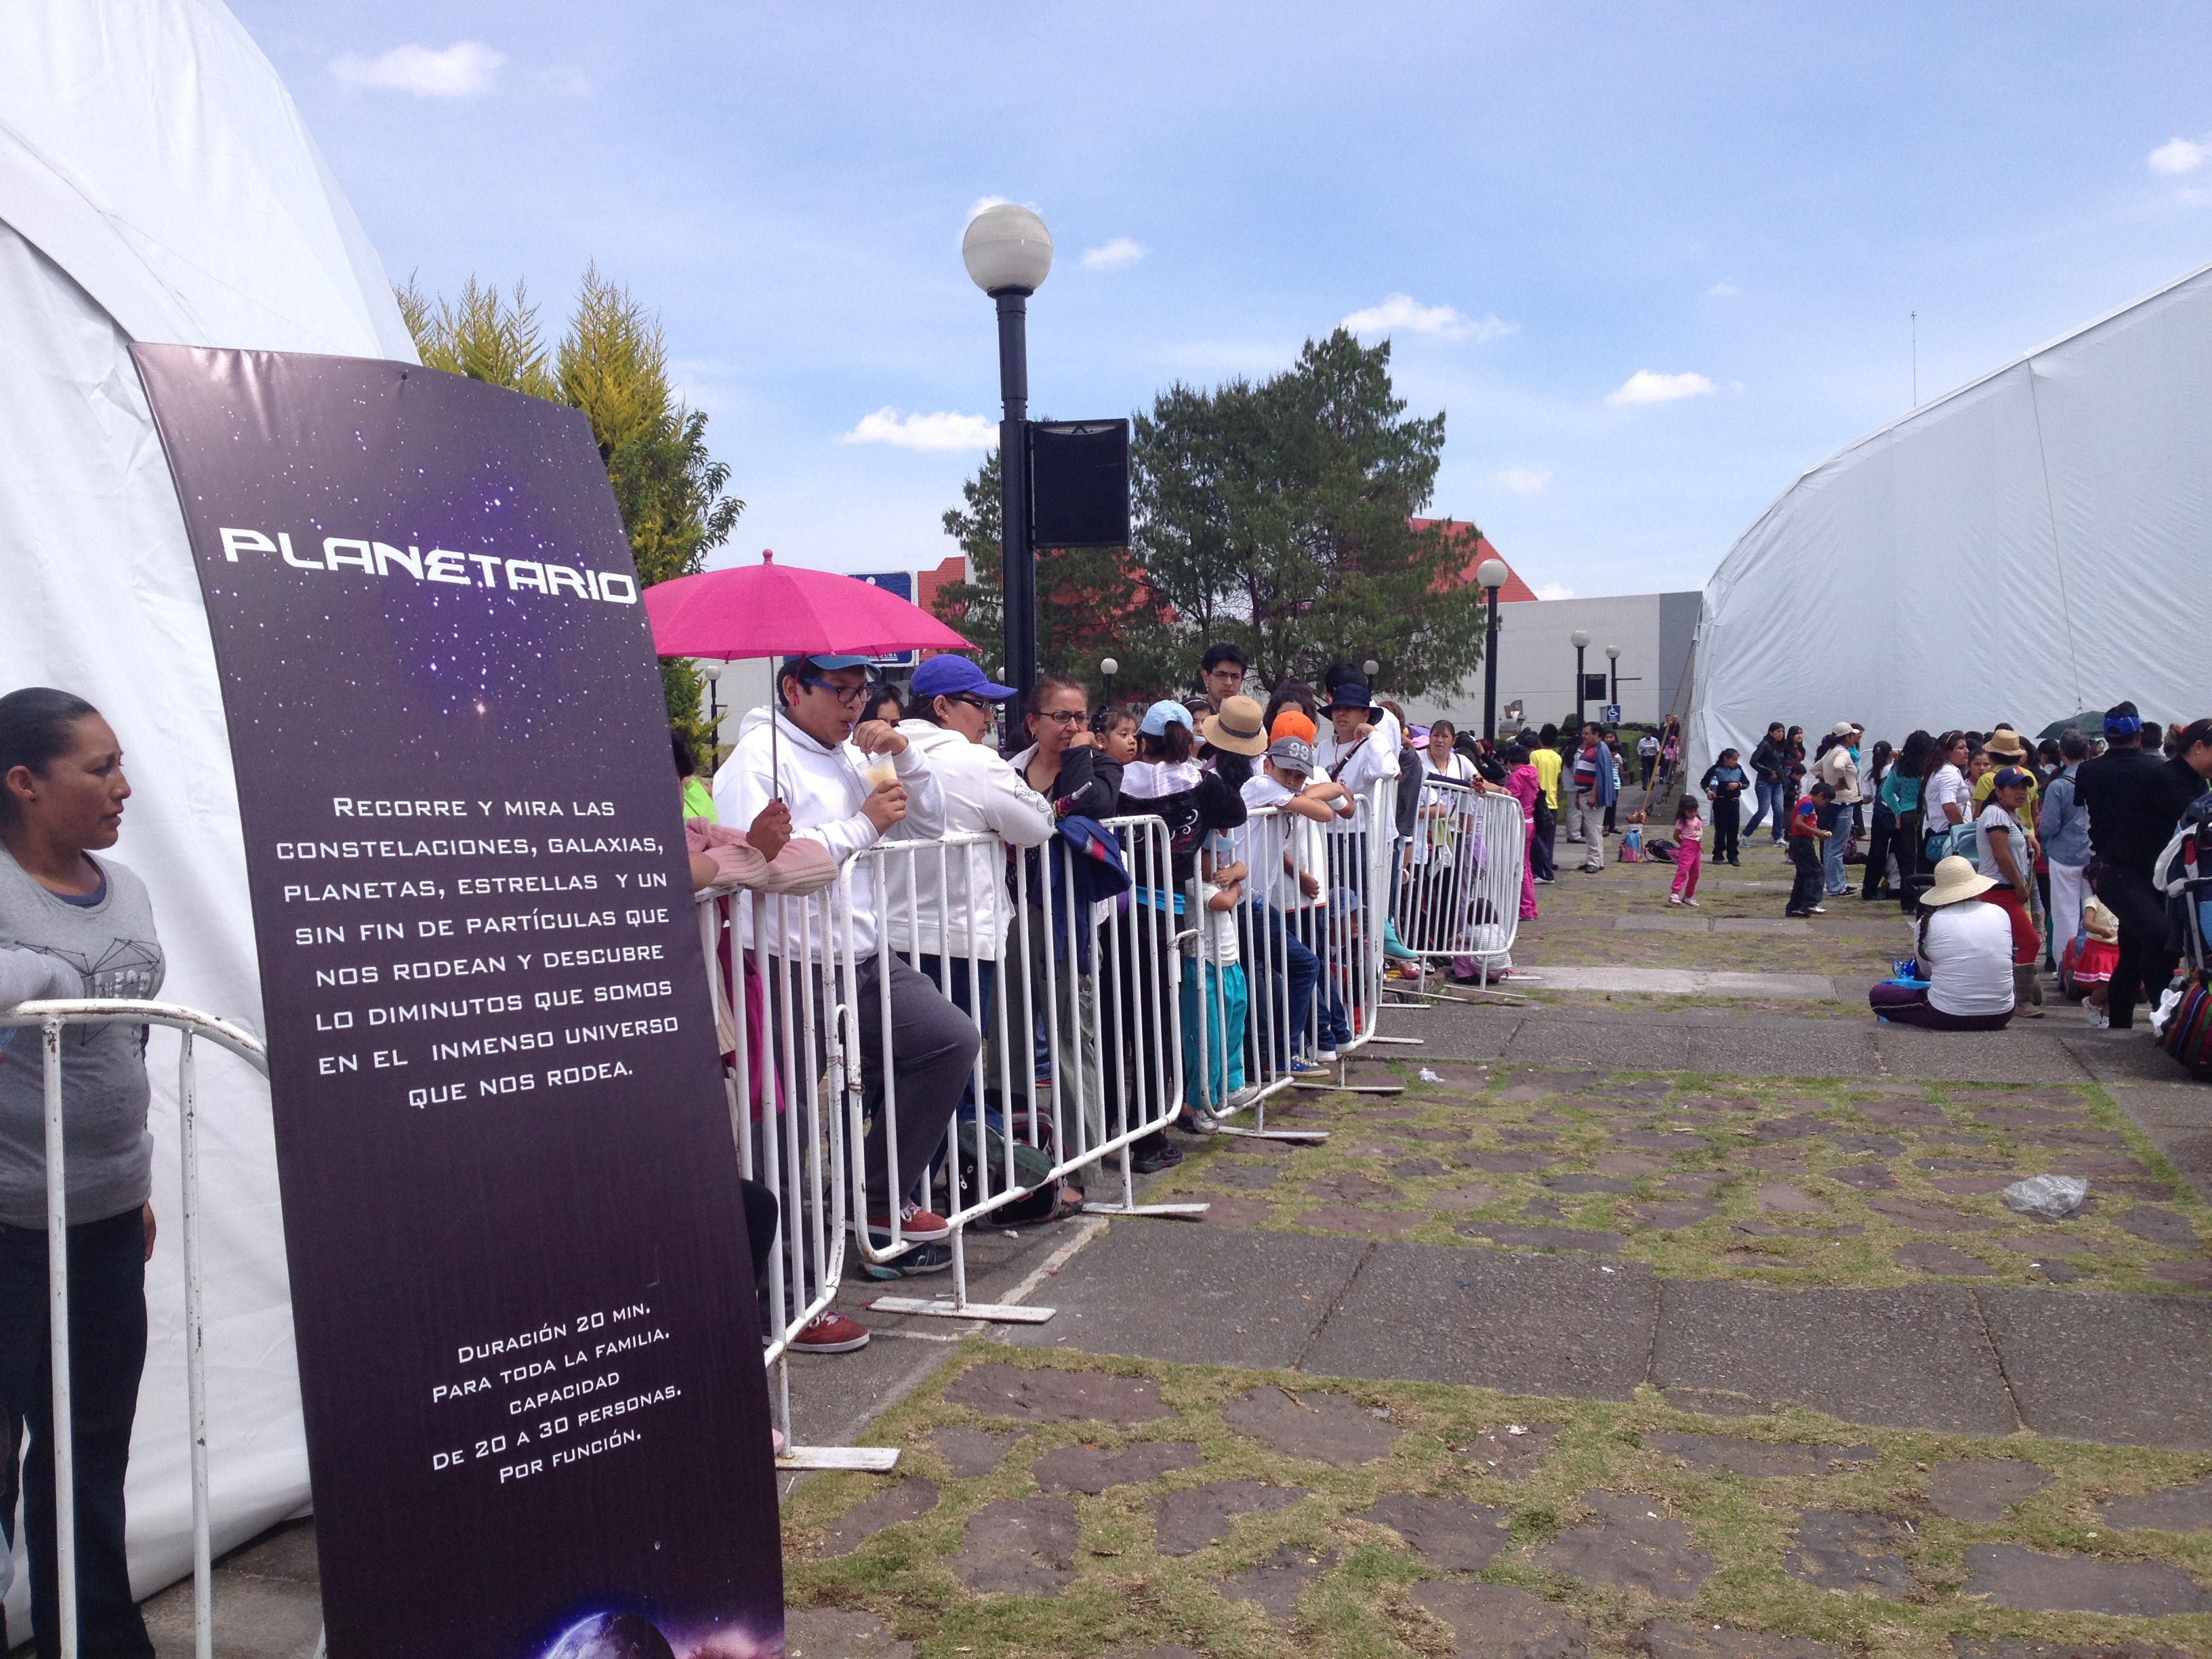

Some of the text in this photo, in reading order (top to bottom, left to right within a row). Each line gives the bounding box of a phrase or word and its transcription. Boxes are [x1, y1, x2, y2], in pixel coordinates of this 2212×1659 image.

[220, 527, 637, 605] PLANETARIO
[477, 801, 493, 815] Y
[505, 801, 564, 816] MIRA
[573, 802, 615, 815] LAS
[276, 838, 663, 859] CONSTELACIONES, GALAXIAS,
[284, 873, 667, 902] PLANETAS, ESTRELLAS Y UN
[295, 908, 669, 945] SIN FIN DE PARTÍCULAS QUE
[316, 945, 664, 987] NOS RODEAN Y DESCUBRE
[316, 981, 672, 1031] LO DIMINUTOS QUE SOMOS
[319, 1017, 678, 1075] EN EL INMENSO UNIVERSO
[409, 1061, 632, 1109] QUE NOS RODEA.
[577, 1312, 605, 1332] 20
[613, 1303, 650, 1322] MIN.
[500, 1359, 556, 1384] TODA
[565, 1351, 588, 1367] LA
[596, 1329, 669, 1358] FAMILIA.
[510, 1372, 619, 1414] CAPACIDAD
[476, 1435, 506, 1458] 20
[517, 1431, 530, 1446] A
[539, 1416, 568, 1439] 30
[578, 1385, 681, 1427] PERSONAS.
[552, 1429, 640, 1467] FUNCIÓN.
